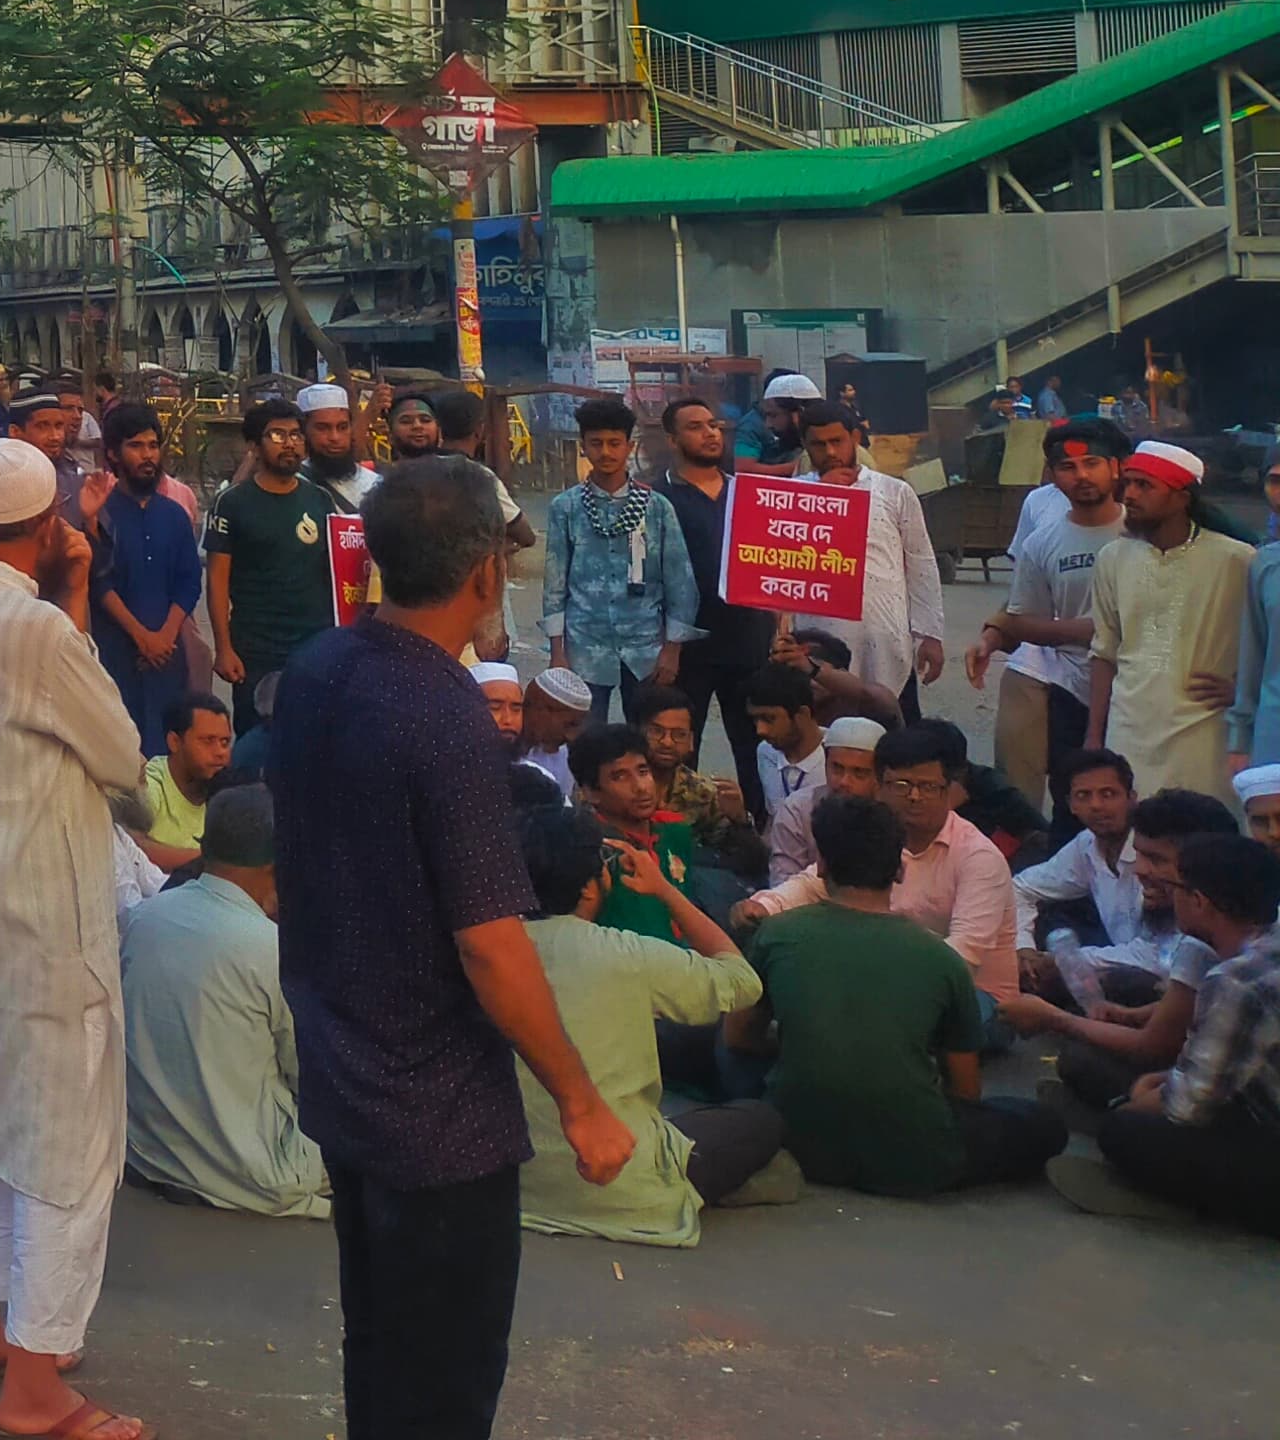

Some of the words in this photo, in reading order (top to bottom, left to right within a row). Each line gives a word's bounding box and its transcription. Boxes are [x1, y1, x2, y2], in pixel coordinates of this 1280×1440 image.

[460, 96, 496, 116] ফর
[756, 488, 795, 510] সারা
[798, 493, 850, 517] বাংলা
[767, 518, 809, 543] খবর
[812, 524, 833, 544] দে
[738, 543, 817, 571] আওয়ামী
[820, 549, 857, 576] লীগ
[760, 575, 807, 600] কবর
[810, 583, 831, 602] দে
